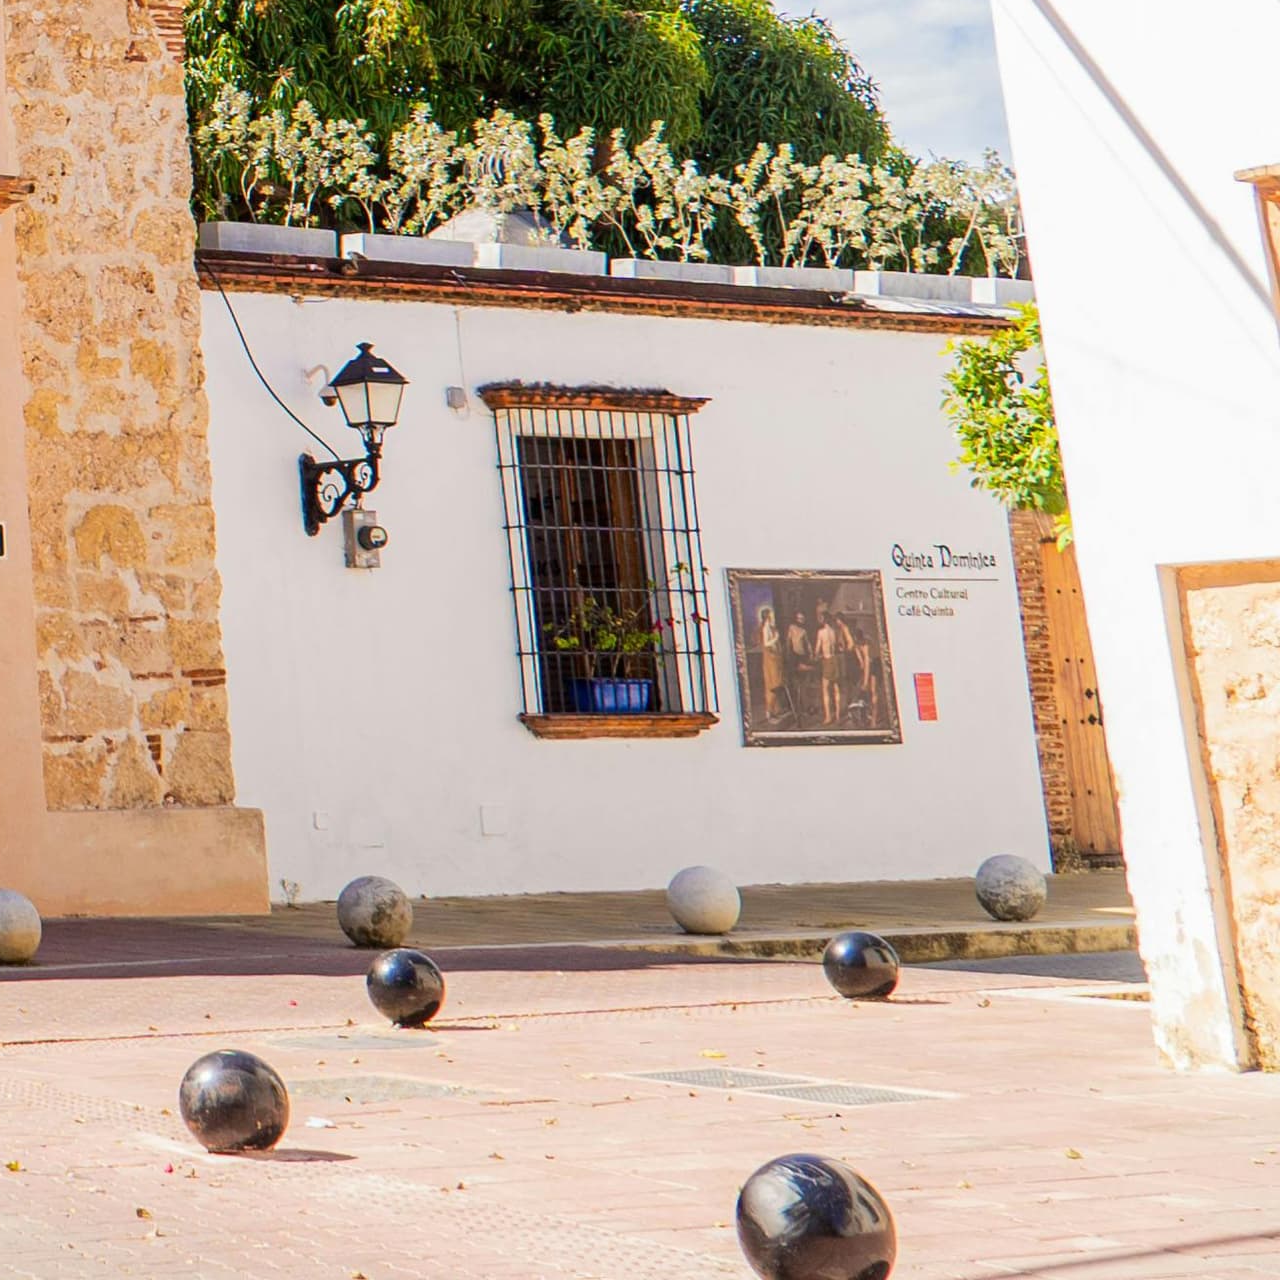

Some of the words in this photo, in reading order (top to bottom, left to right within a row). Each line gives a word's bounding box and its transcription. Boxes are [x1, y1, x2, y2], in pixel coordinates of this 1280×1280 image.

[892, 544, 933, 572] Quinta
[933, 544, 996, 569] Dominica
[896, 587, 928, 599] Centro
[930, 588, 968, 600] Cultural
[922, 605, 954, 618] Quinta
